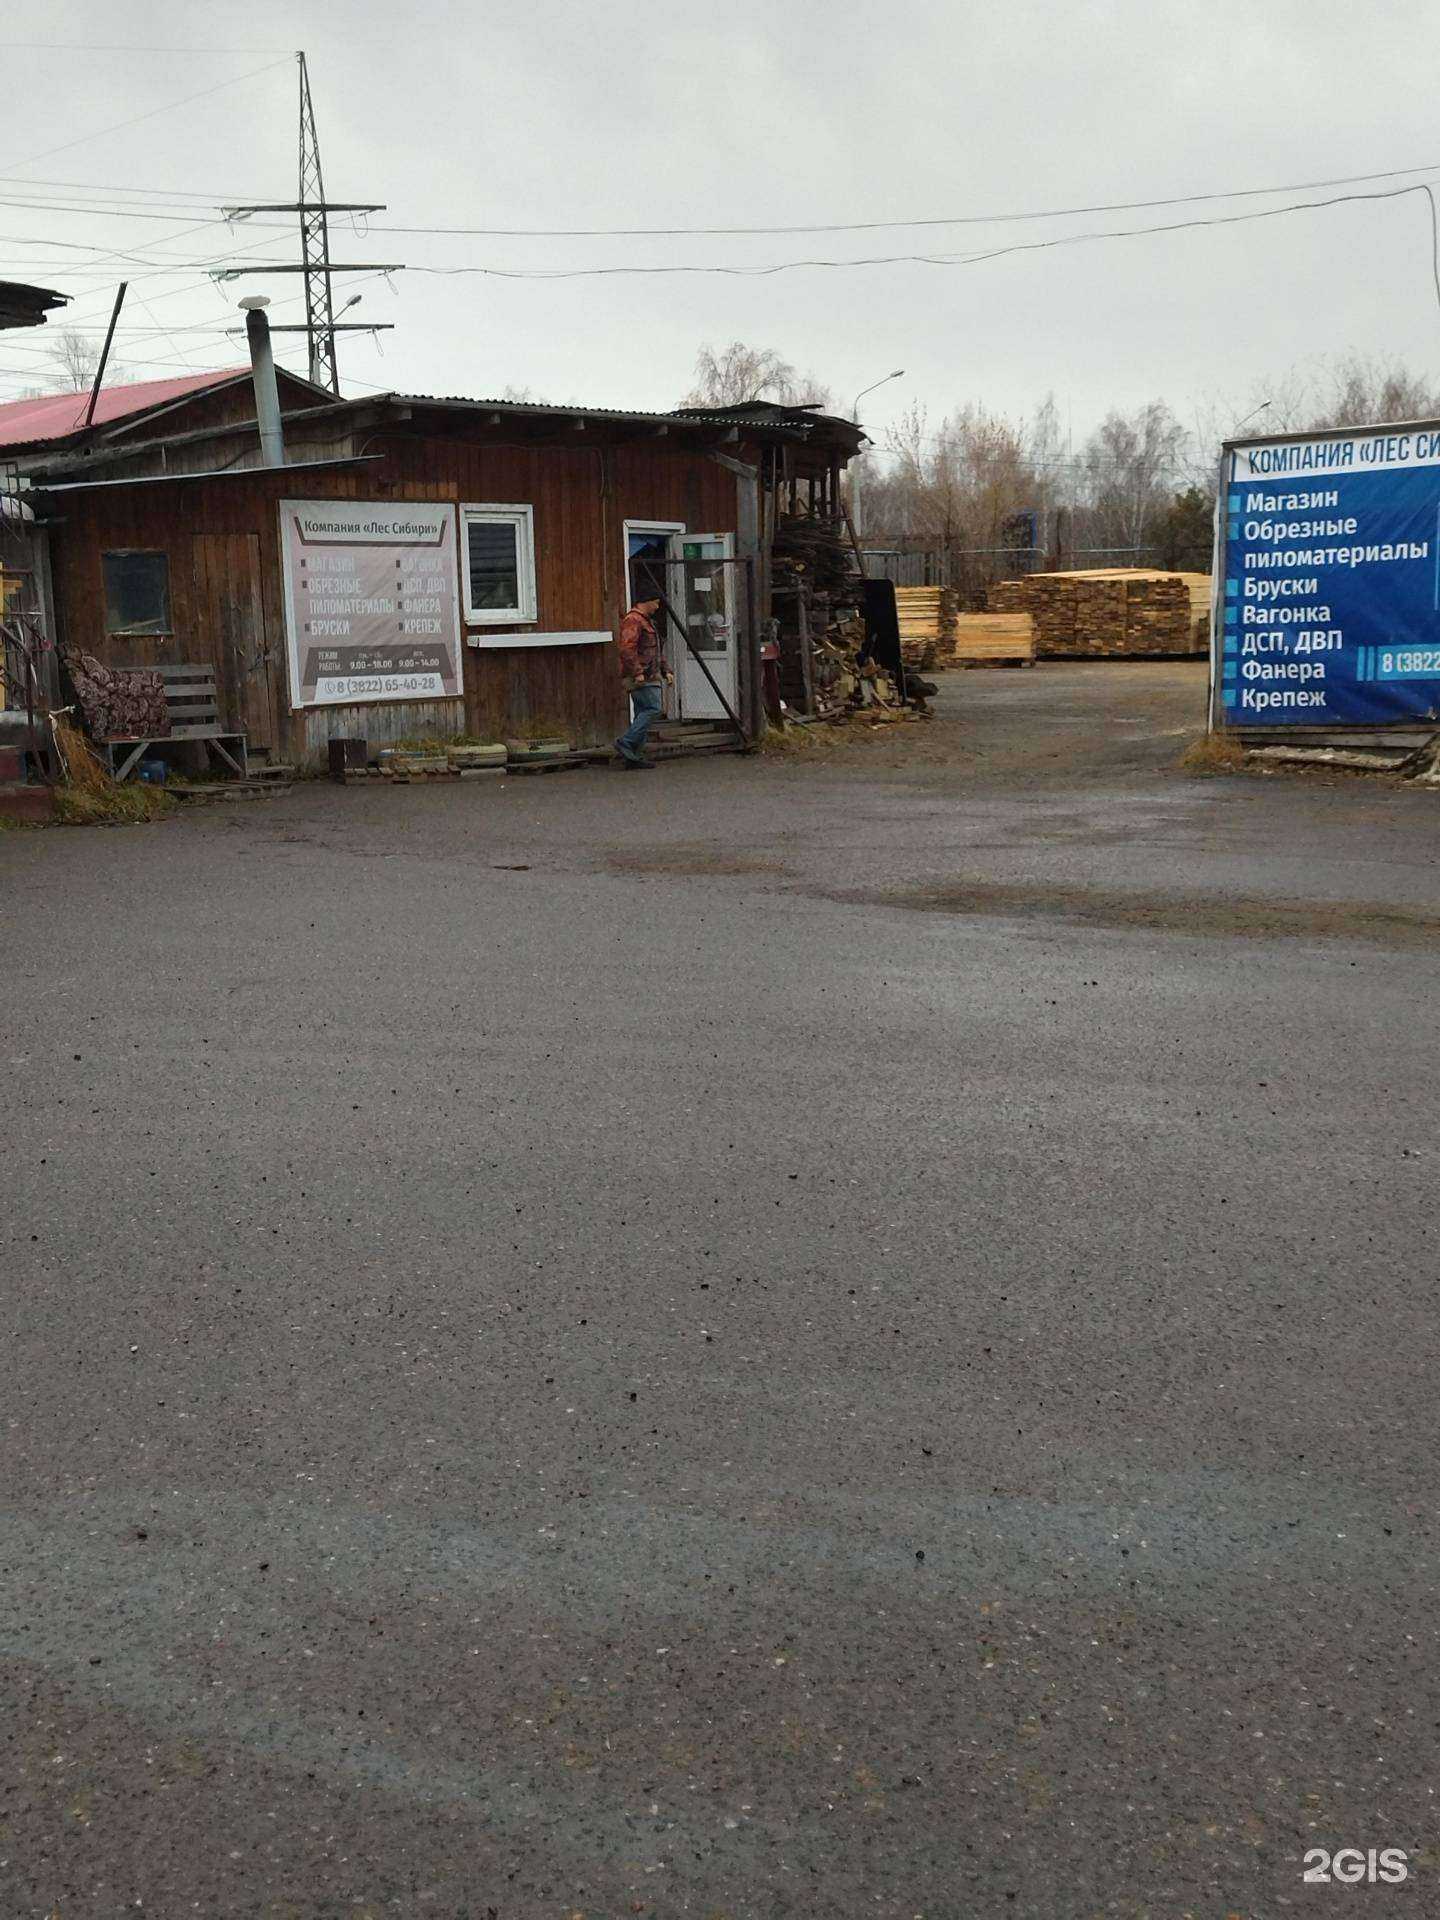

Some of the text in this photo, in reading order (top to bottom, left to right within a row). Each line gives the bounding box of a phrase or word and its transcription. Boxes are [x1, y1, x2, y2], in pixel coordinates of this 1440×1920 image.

[1248, 441, 1354, 474] КОМПАНИЯ
[1360, 436, 1410, 464] «ЛЕС
[1246, 488, 1340, 514] Магазин
[304, 520, 438, 536] Компания «Лес Сибири»
[1244, 517, 1358, 544] Обрезные
[1244, 540, 1430, 569] пиломатериалы
[308, 577, 362, 594] ОБРЕЗНЫЕ
[1244, 575, 1318, 602] Бруски
[309, 599, 394, 615] ПИЛОМАТЕРИАЛЫ
[404, 599, 441, 614] ФАНЕРА
[1243, 604, 1331, 625] Вагонка
[310, 620, 351, 636] БРУСКИ
[404, 619, 442, 635] КРЕПЕЖ
[1242, 629, 1343, 656] ДСП, ДВП
[1241, 659, 1327, 684] Фанера
[1382, 652, 1394, 673] 8
[337, 677, 436, 695] 8 (3822) 65-40-28
[1241, 688, 1327, 712] Крепеж
